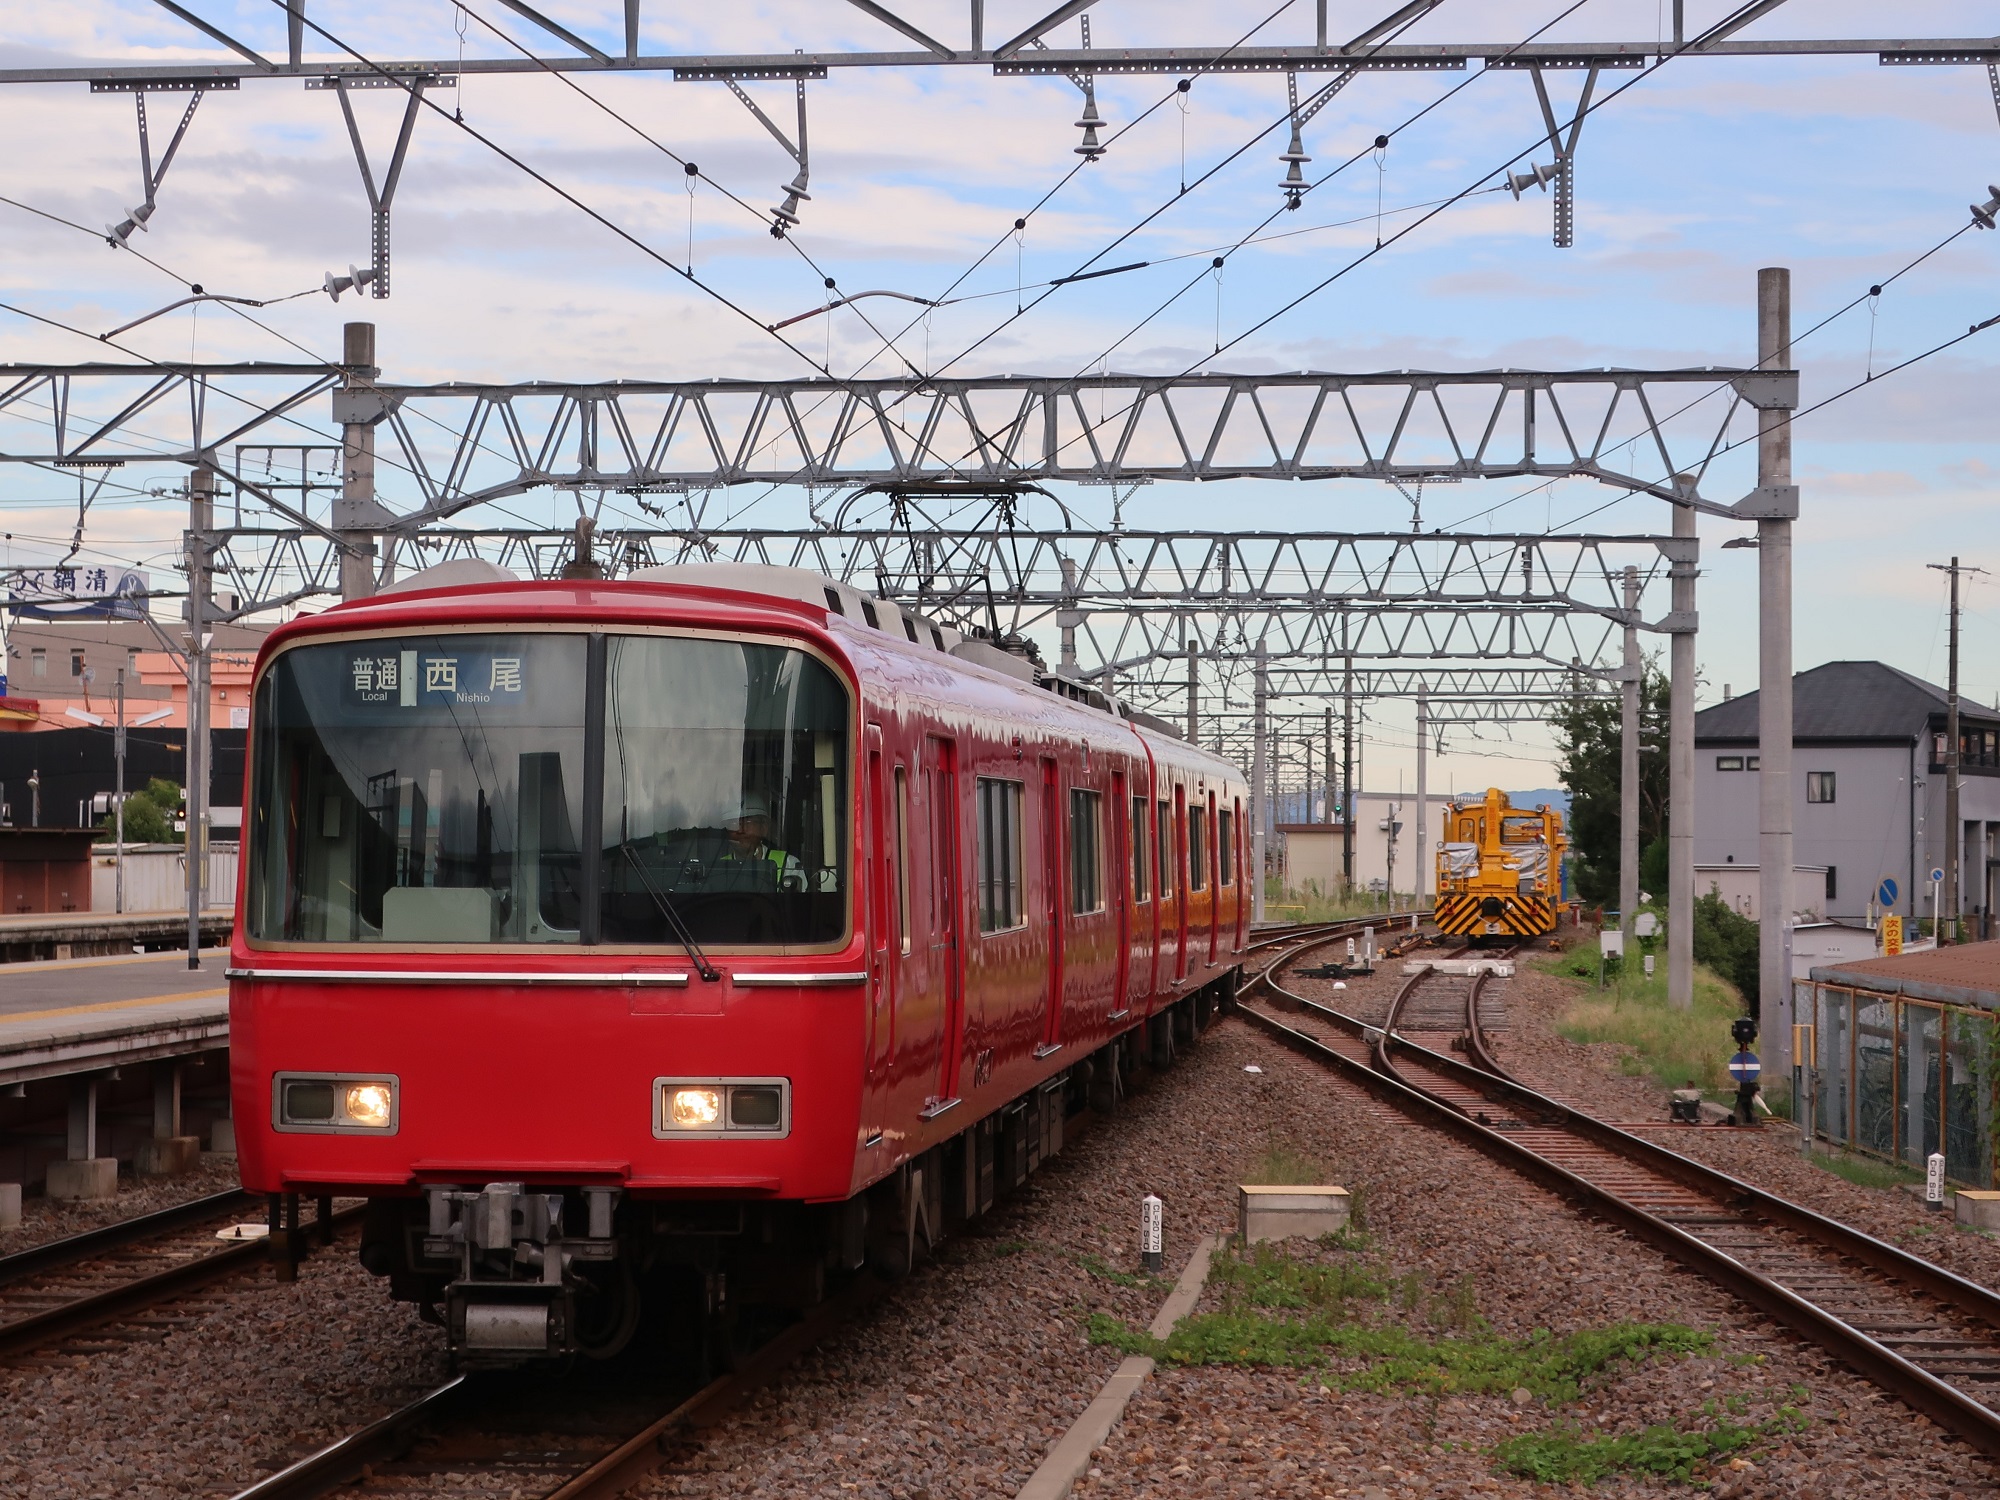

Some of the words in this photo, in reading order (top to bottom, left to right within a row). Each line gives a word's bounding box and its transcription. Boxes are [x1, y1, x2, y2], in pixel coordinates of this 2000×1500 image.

[53, 568, 108, 592] 鍋清
[353, 657, 398, 691] 普通
[426, 658, 522, 692] 西尾
[362, 692, 388, 701] Local
[456, 693, 490, 702] Nishio
[1152, 1204, 1160, 1251] CL=20.770
